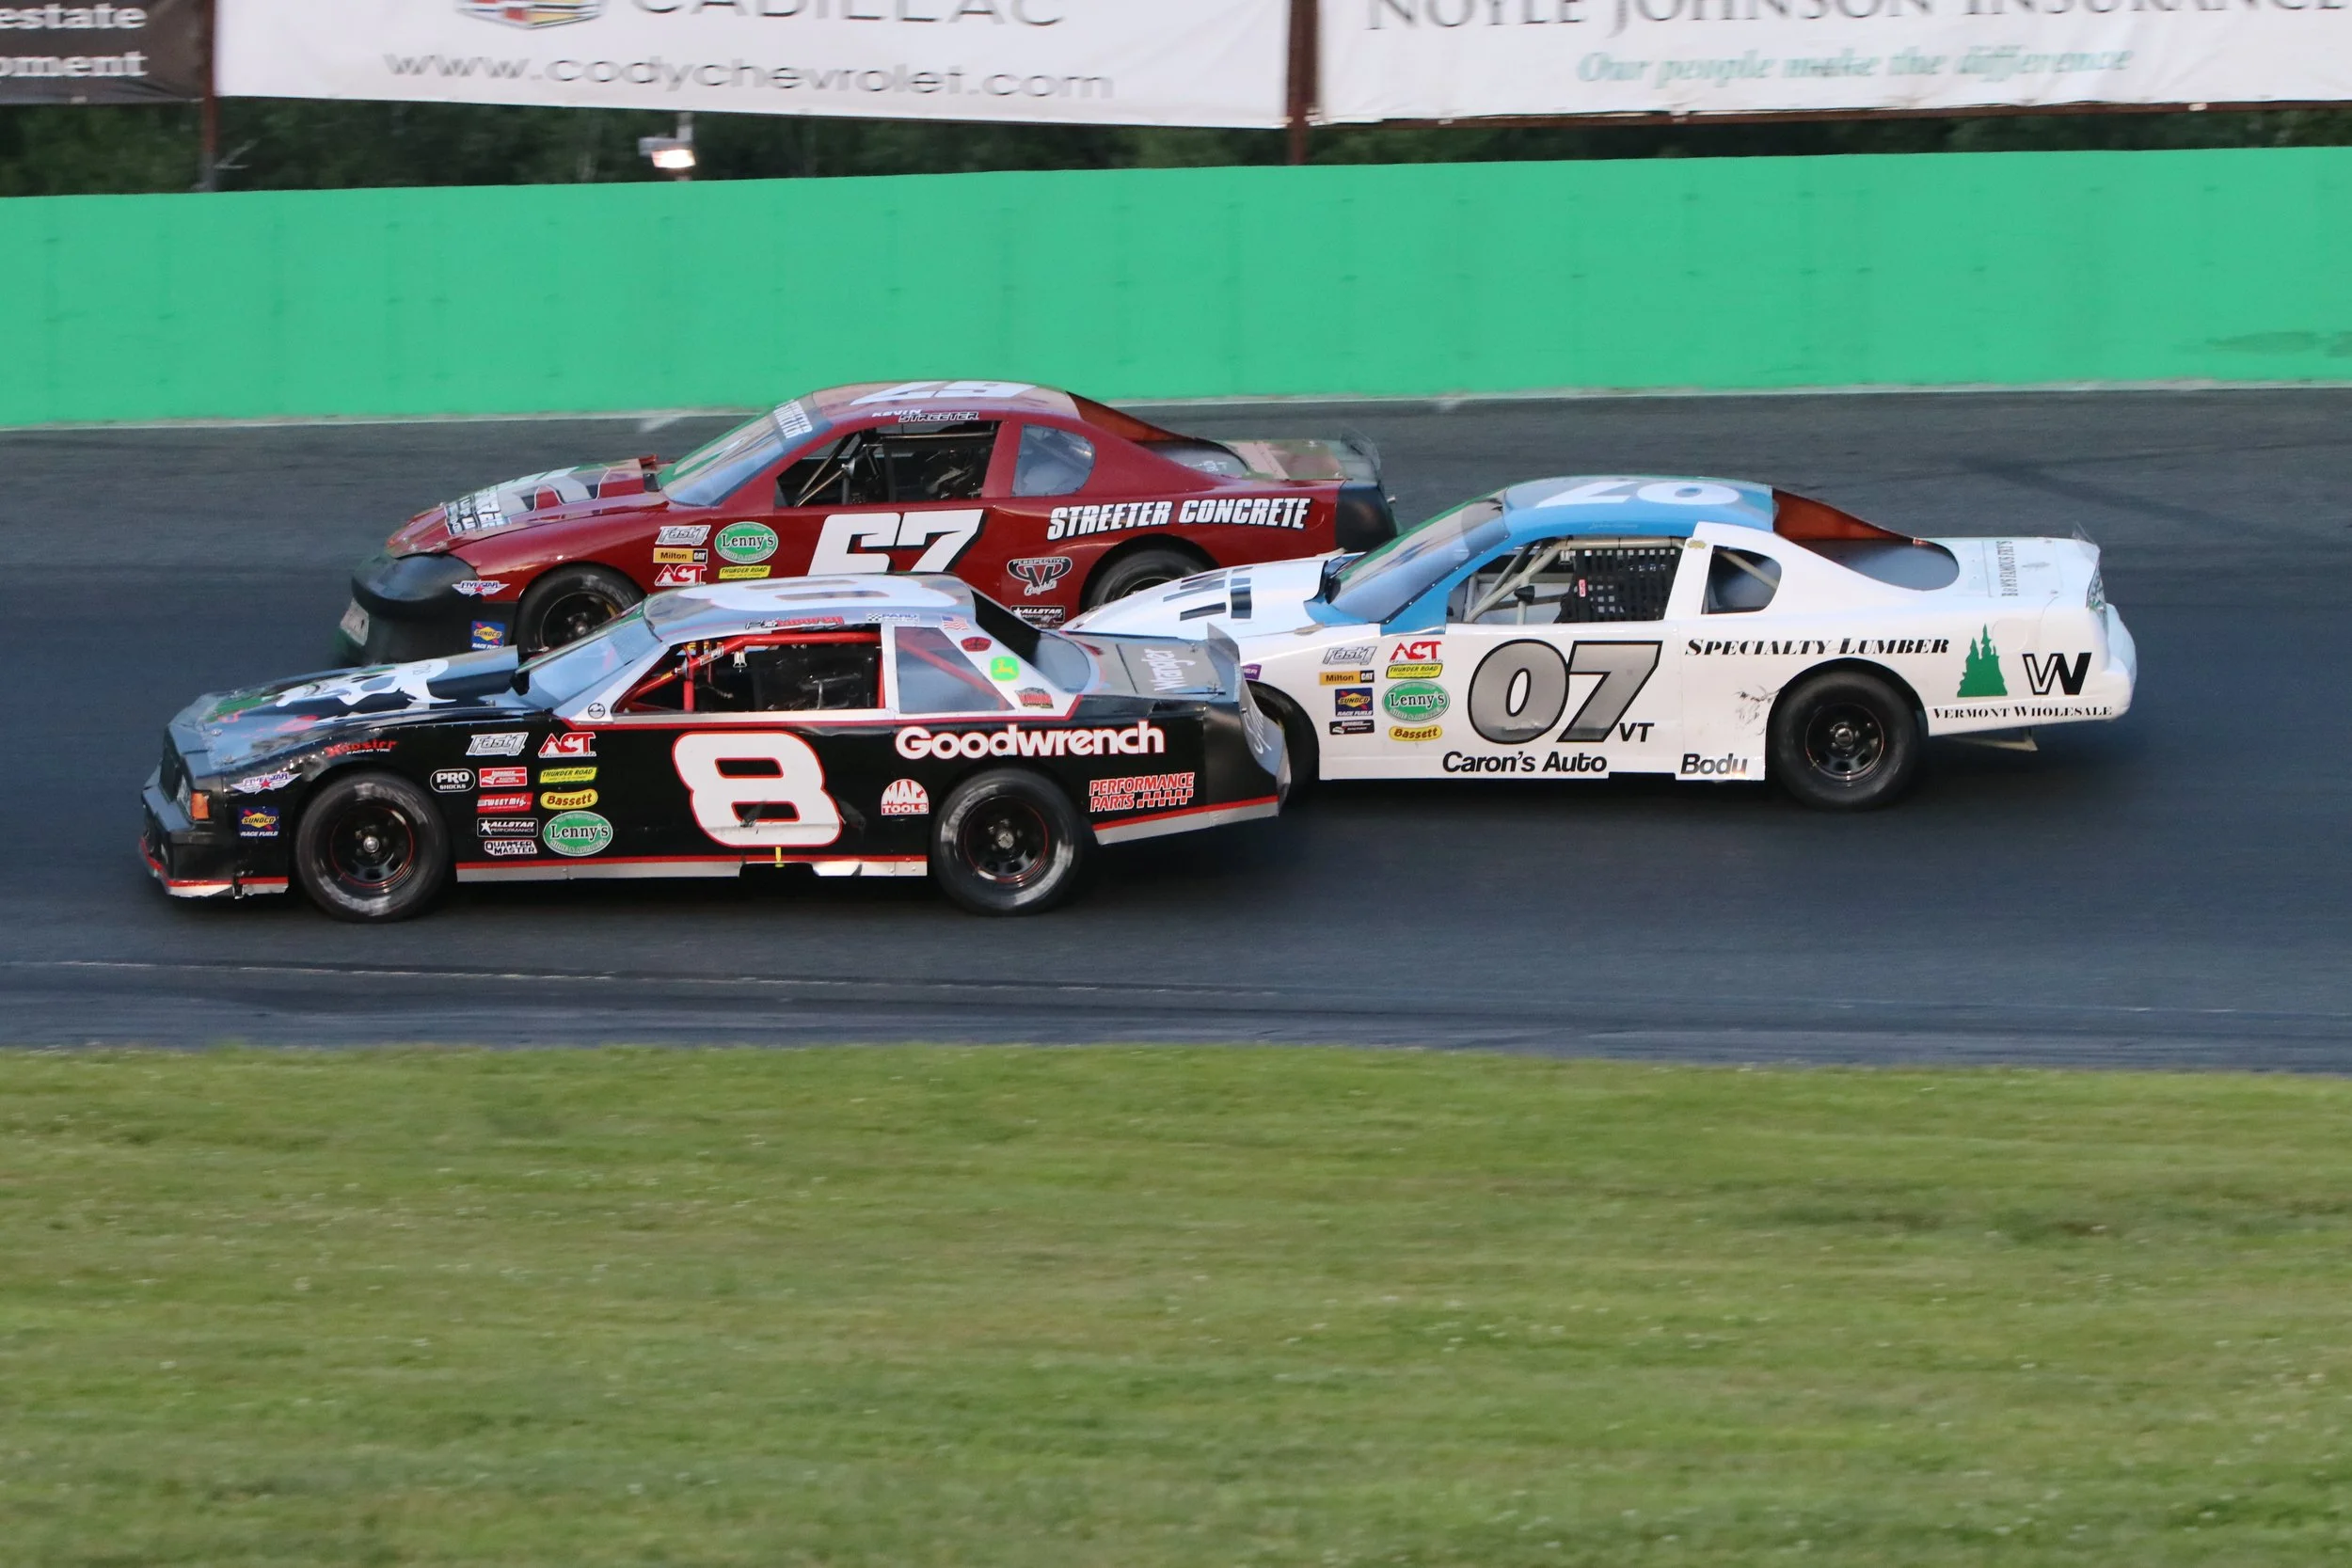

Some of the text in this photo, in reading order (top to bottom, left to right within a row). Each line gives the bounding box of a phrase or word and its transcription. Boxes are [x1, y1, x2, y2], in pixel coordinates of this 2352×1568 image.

[1578, 43, 2133, 89] Our people make the difference
[383, 53, 1115, 100] www.codychevrolet.com
[871, 408, 923, 418] KEVIN
[898, 412, 979, 423] STREETER
[1046, 498, 1311, 541] STREETER CONCRETE
[721, 533, 775, 550] Lenny's
[660, 551, 707, 561] Milton CAT
[655, 564, 707, 583] ACT
[475, 628, 501, 638] SUNOCO
[1390, 641, 1442, 661] ACT
[1685, 638, 1950, 656] SPECIALTY LUMBER
[1360, 672, 1375, 681] CAT
[1390, 692, 1445, 709] Lenny's
[1467, 639, 1663, 745] 07
[1933, 705, 2114, 720] VERMONT WHOLESALE
[896, 720, 1166, 759] Goodwrench
[1393, 727, 1438, 738] Bassett
[1619, 722, 1655, 742] VT
[539, 733, 596, 753] ACT
[1442, 751, 1748, 775] Caron's Auto Body
[243, 776, 263, 786] FIVE
[436, 771, 469, 784] PRO
[1089, 772, 1195, 797] PERFORMANCE
[672, 730, 843, 847] 8
[883, 780, 926, 800] MAC
[547, 793, 593, 806] Bassett
[1089, 794, 1135, 813] PARTS
[882, 804, 929, 814] TOOLS
[242, 816, 275, 825] SUNOCO
[550, 823, 609, 843] Lenny's
[485, 841, 532, 851] QUARTER
[494, 847, 535, 855] MASTER
